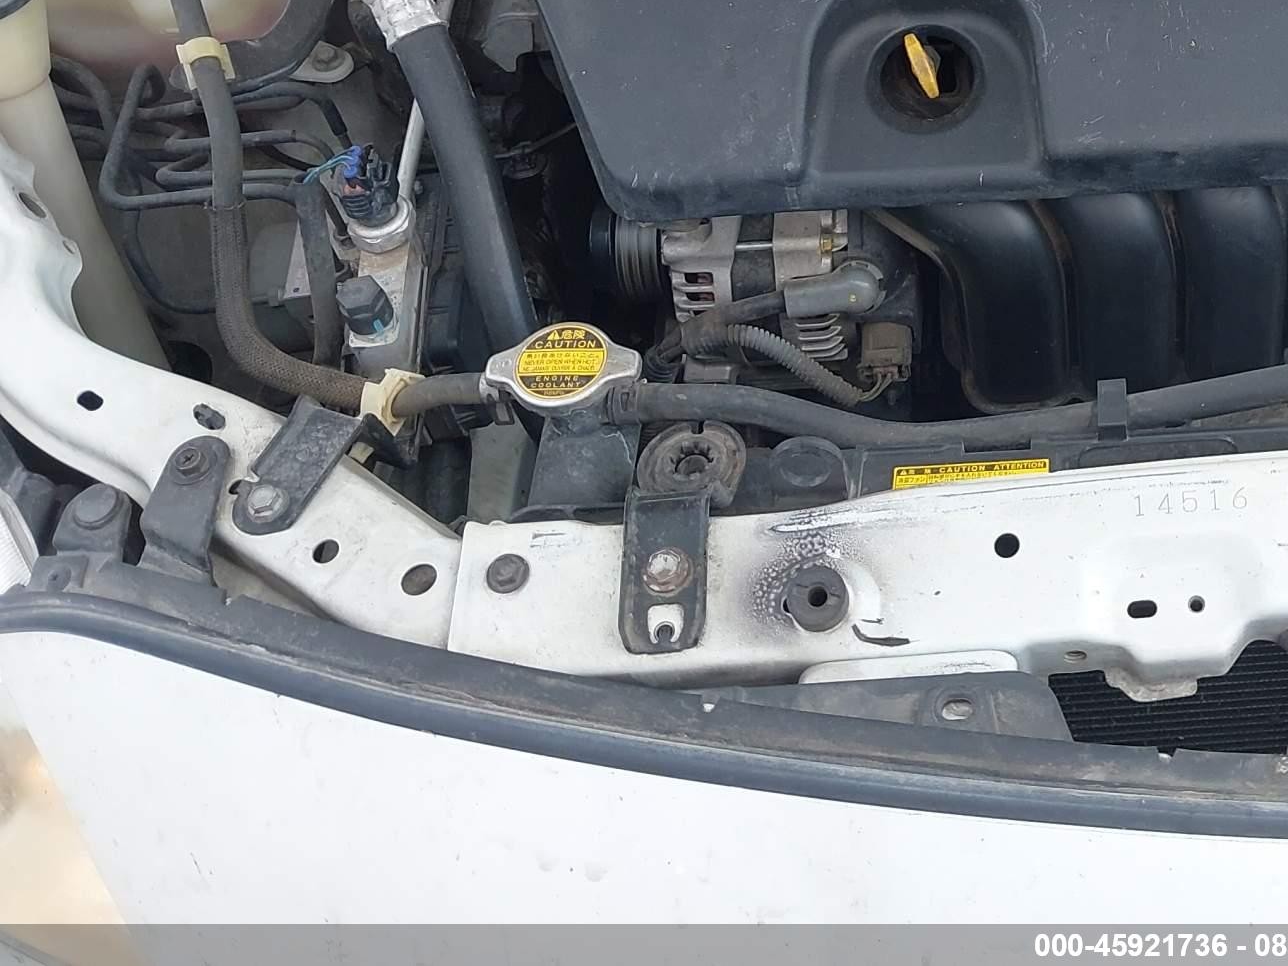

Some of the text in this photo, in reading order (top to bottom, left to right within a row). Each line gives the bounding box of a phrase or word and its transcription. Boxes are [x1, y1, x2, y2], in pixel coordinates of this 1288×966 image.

[535, 340, 596, 349] CAUTION
[939, 464, 986, 474] CAUTION
[993, 460, 1045, 471] ATTENTION
[1134, 487, 1248, 517] 14516
